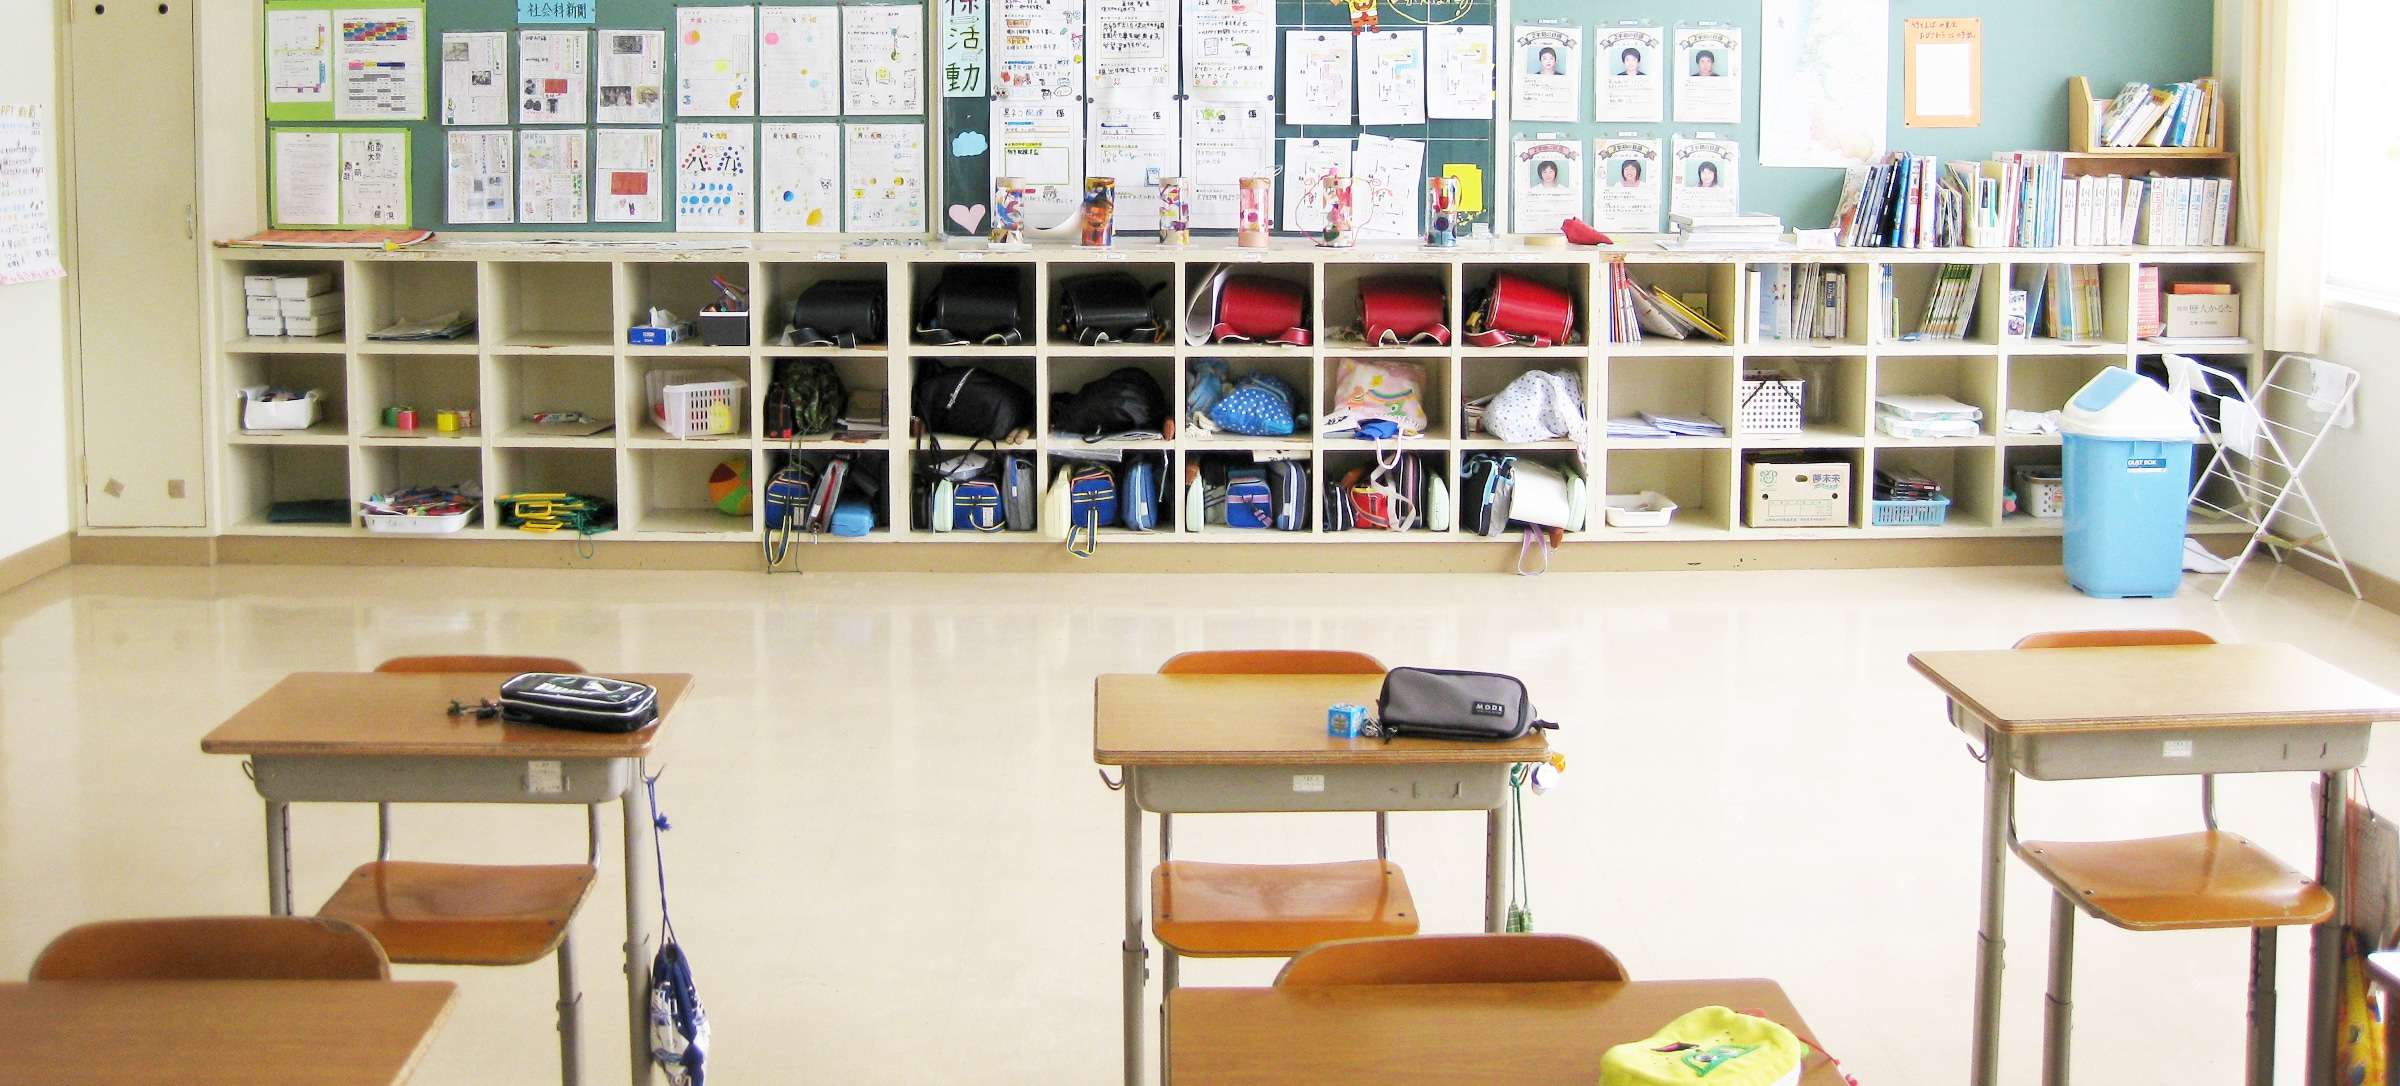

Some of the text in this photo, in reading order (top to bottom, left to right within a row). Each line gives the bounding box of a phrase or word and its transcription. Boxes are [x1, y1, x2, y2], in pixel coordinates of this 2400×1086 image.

[527, 2, 587, 19] 社会科新聞
[1812, 474, 1841, 483] 夢未来
[1475, 703, 1503, 711] MODE
